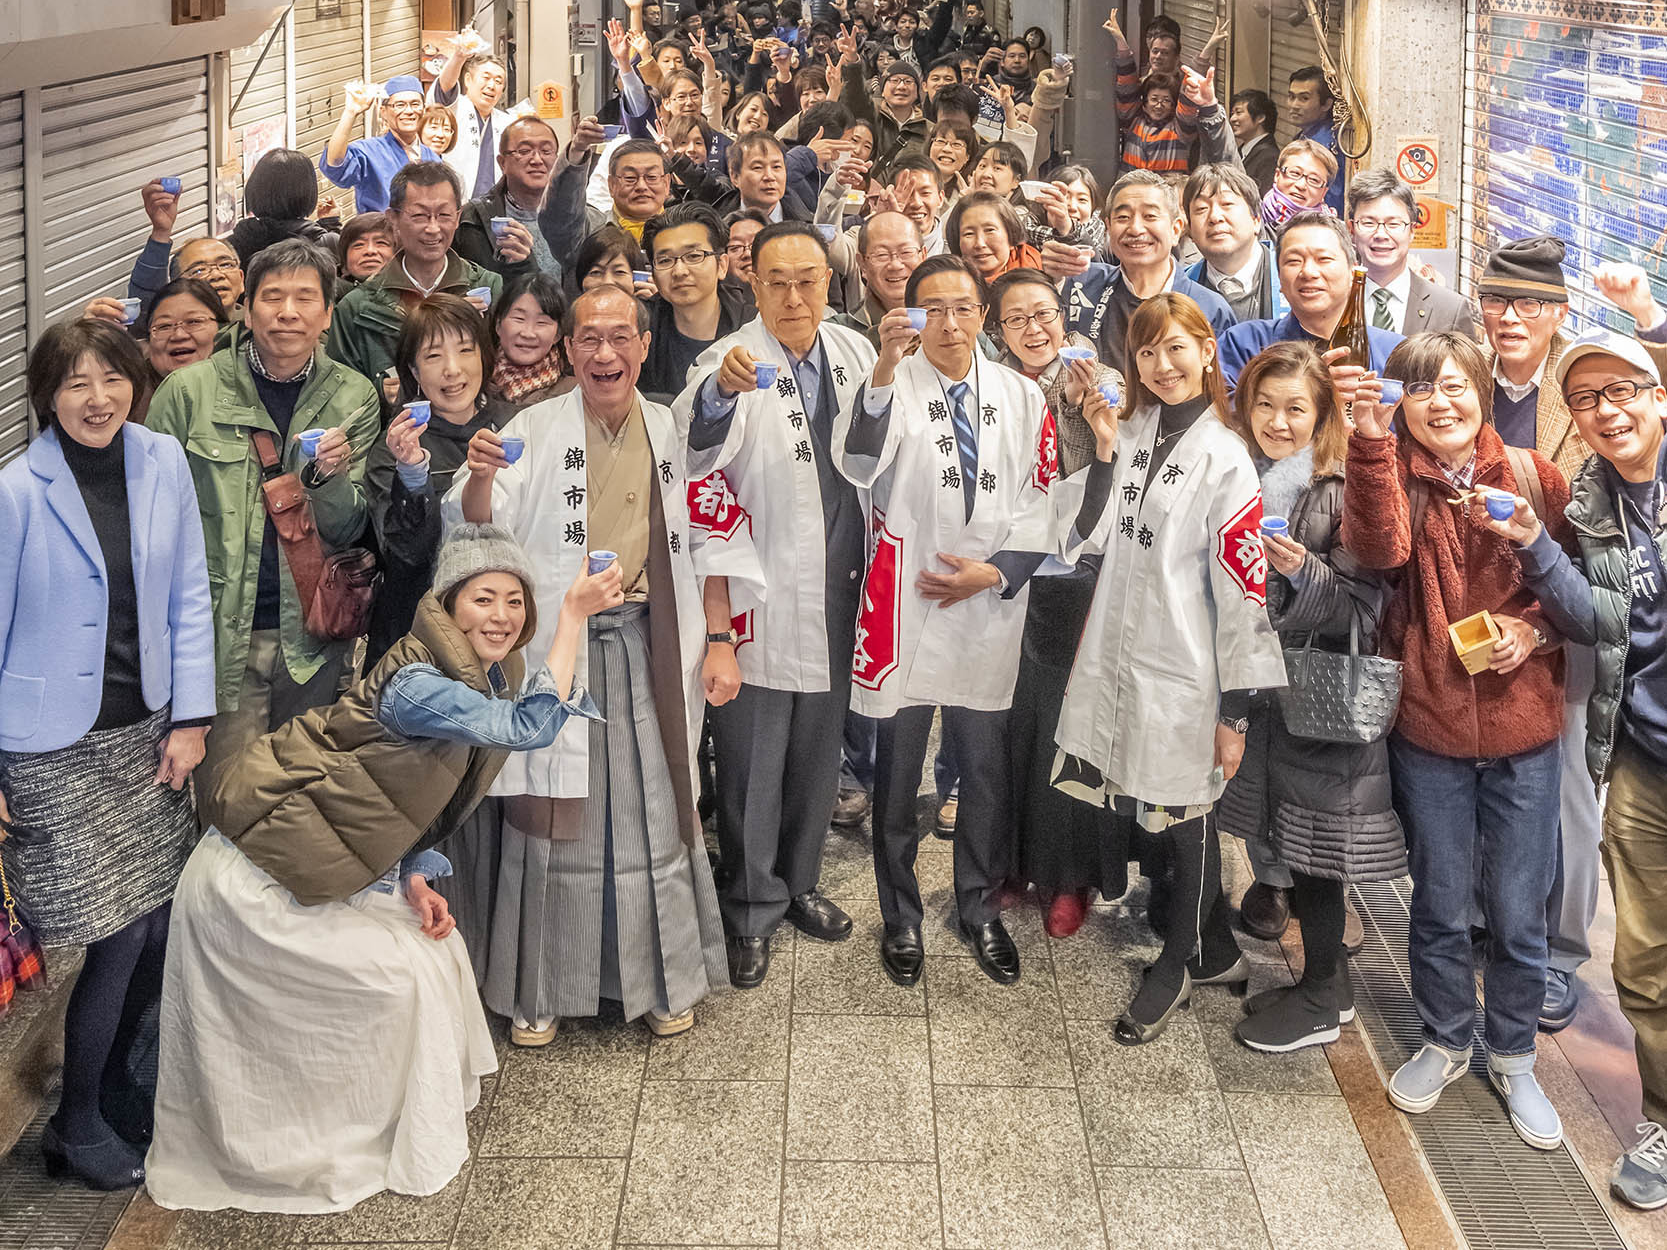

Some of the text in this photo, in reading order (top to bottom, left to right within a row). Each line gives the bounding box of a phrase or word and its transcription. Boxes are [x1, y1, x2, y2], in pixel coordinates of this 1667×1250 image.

[776, 377, 813, 464] 錦市場
[832, 364, 848, 387] 京
[928, 400, 962, 490] 錦市場
[981, 403, 997, 495] 京都
[563, 447, 586, 546] 錦市場
[658, 459, 681, 555] 京都
[1120, 448, 1150, 541] 錦市場
[1137, 462, 1185, 550] 京都
